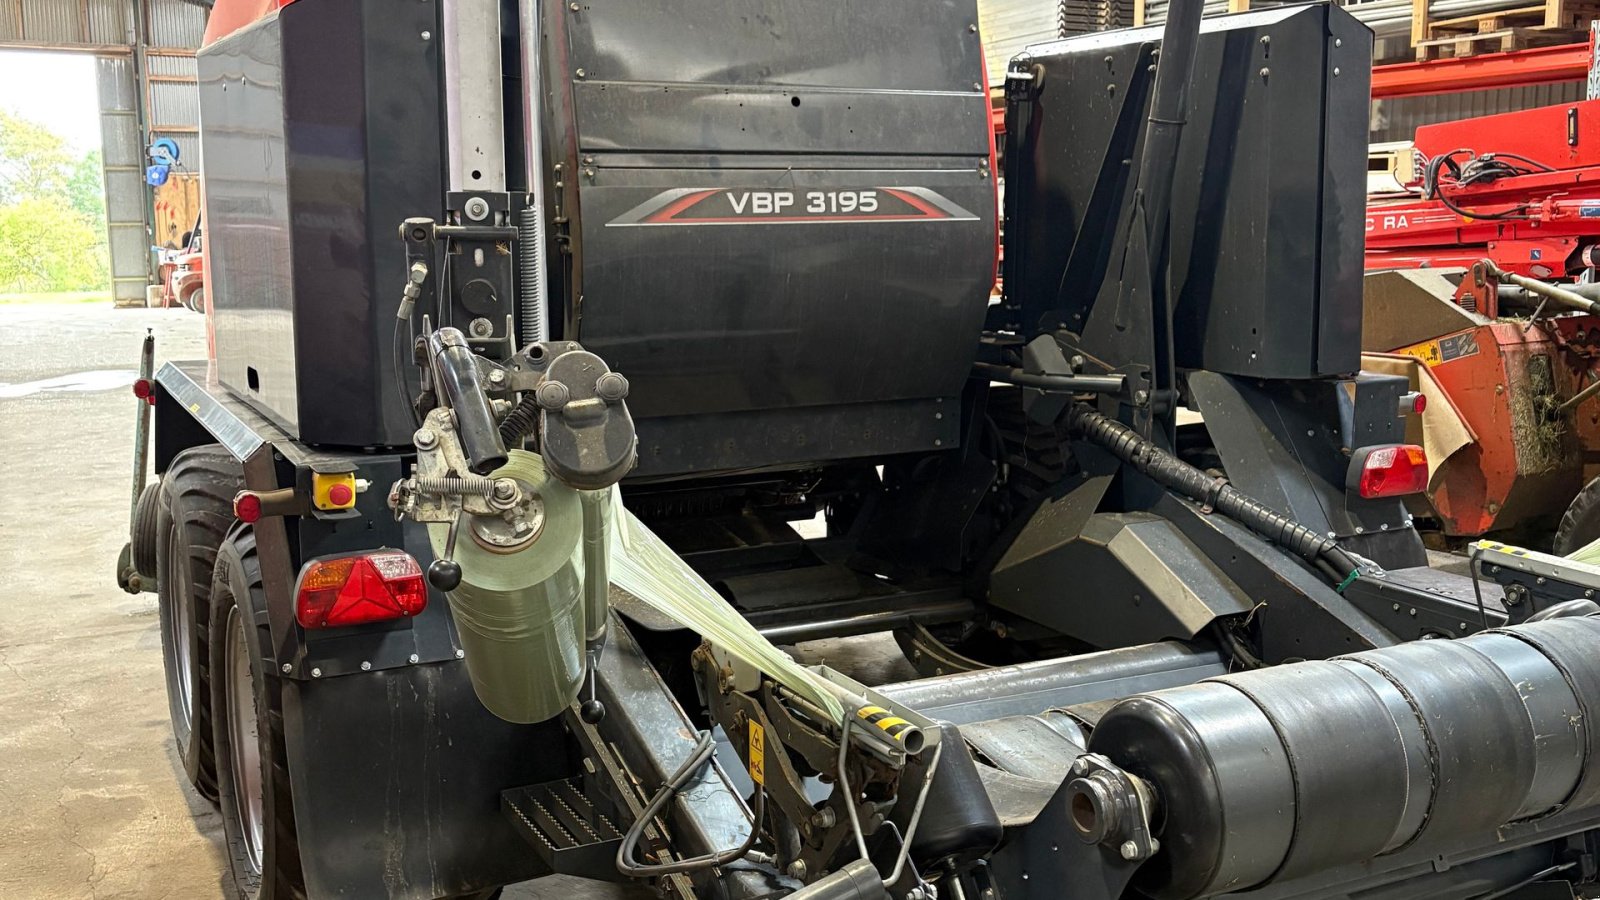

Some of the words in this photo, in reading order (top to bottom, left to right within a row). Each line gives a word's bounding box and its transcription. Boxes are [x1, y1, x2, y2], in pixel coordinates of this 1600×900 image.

[726, 192, 794, 213] VBP
[806, 191, 878, 212] 3195
[1383, 215, 1409, 230] RA
